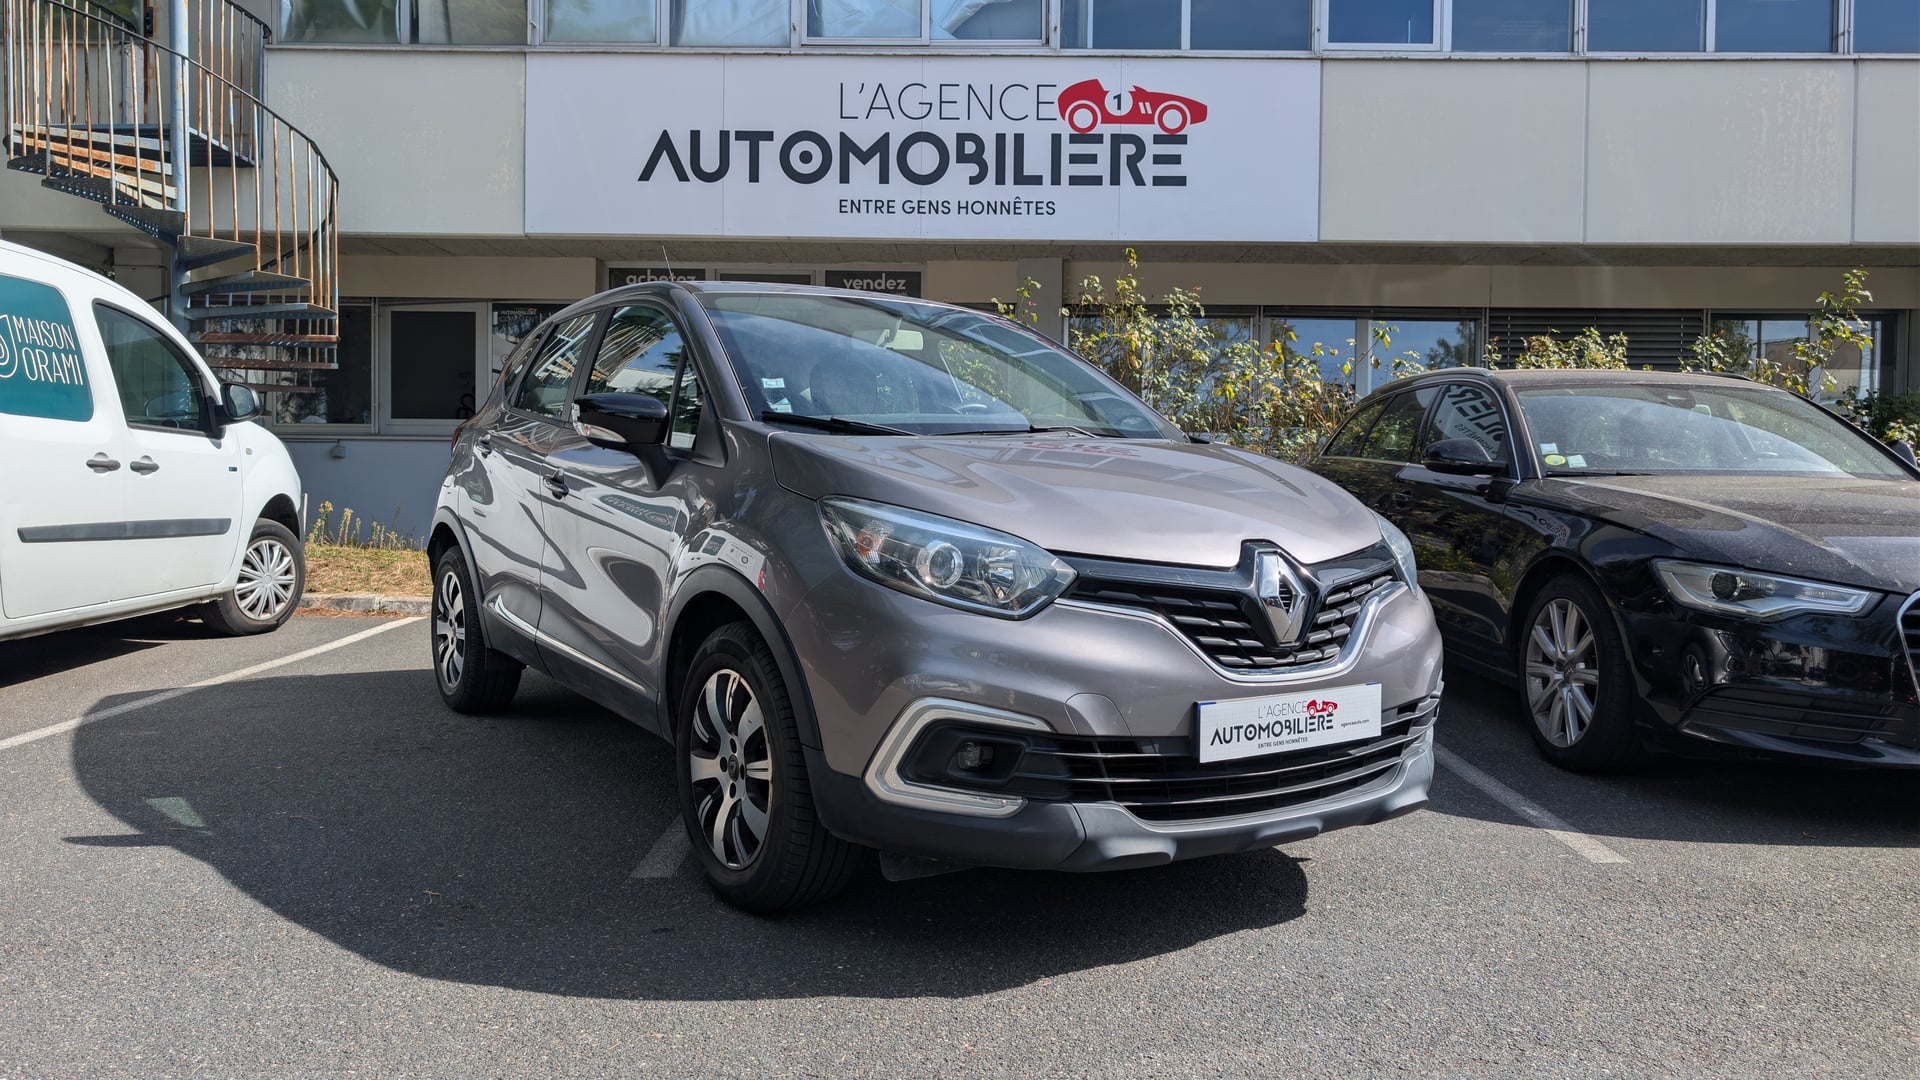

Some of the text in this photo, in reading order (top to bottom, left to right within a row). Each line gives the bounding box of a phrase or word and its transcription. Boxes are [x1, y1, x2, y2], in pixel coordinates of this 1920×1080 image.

[838, 82, 1058, 121] L'AGENCE
[1113, 93, 1121, 111] 1
[838, 195, 1056, 216] ENTRE GENS HONNÊTES
[842, 272, 907, 290] vendez
[12, 315, 76, 351] MAISON
[21, 347, 84, 386] ORAMI
[1257, 701, 1308, 719] L'AGENCE
[1257, 741, 1273, 749] ENTRE
[1273, 739, 1285, 747] GENS
